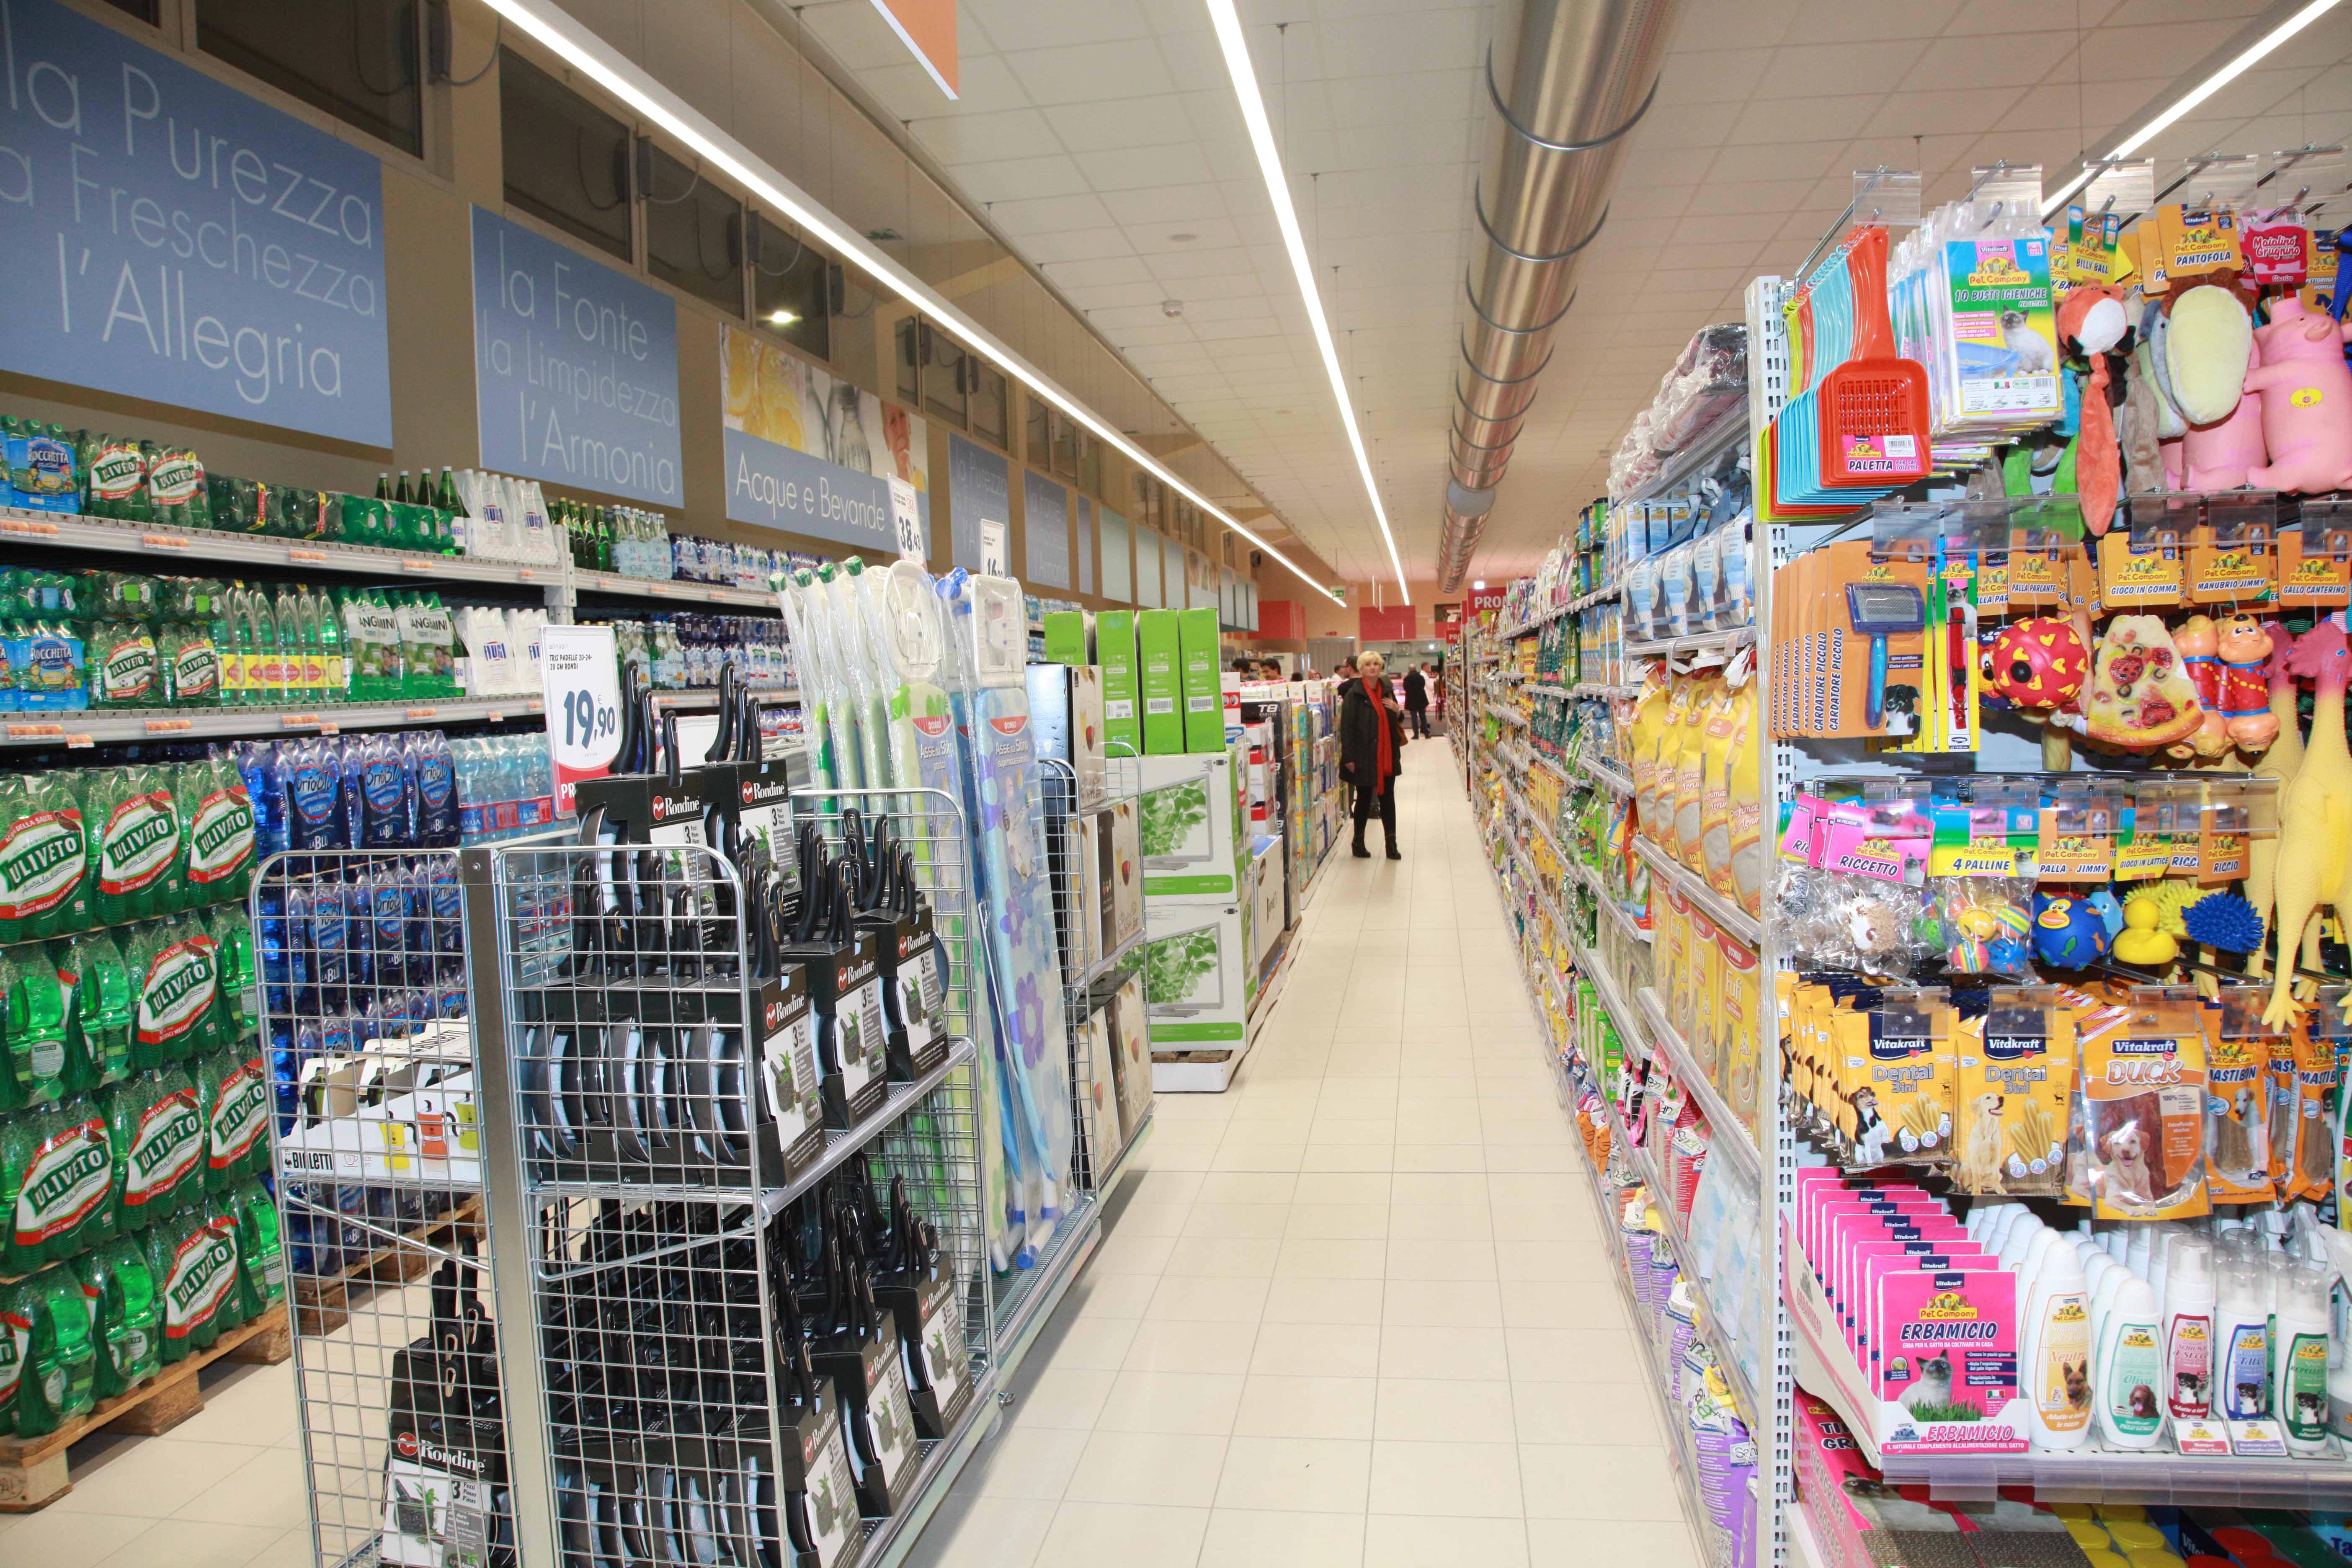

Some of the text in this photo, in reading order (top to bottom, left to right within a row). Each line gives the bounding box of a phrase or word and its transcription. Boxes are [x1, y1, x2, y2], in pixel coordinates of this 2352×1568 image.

[1, 0, 371, 249] la Purezza
[71, 142, 377, 318] Freschezza
[2190, 242, 2226, 251] Company
[2253, 235, 2296, 248] Maialino
[2175, 251, 2232, 266] PANTOFOLA
[2256, 246, 2300, 260] Grugnino
[2076, 257, 2108, 274] BILLY BALL
[1969, 275, 2027, 285] Pet Company
[499, 230, 648, 361] la Fonte
[1955, 288, 2047, 302] 10 BUSTE IGIENICHE
[57, 232, 342, 405] l'Allegria
[482, 311, 676, 428] la Limpidezza
[519, 391, 676, 495] l'Armonia
[1848, 459, 1893, 472] PALETTA
[736, 452, 885, 532] Acque e Bevande
[2133, 573, 2167, 582] Company
[2220, 569, 2256, 577] Company
[2029, 585, 2057, 593] PARLANTE
[2110, 586, 2134, 595] GIOCO
[2147, 585, 2177, 593] GOMMA
[2197, 579, 2265, 591] MANUBRIO JIMMY
[2306, 585, 2346, 594] CANTERINO
[31, 647, 73, 661] ROCCHETTA
[1813, 631, 1827, 732] CARDATORE PICCOLO
[1829, 627, 1844, 731] CARDATORE PICCOLO
[753, 781, 785, 799] Rondine
[665, 796, 700, 816] Rondine
[16, 820, 35, 831] DELLA
[771, 808, 778, 826] 3
[685, 825, 691, 844] 3
[9, 837, 77, 884] ULIVETO
[1839, 855, 1898, 876] RICCETTO
[1952, 858, 2010, 871] 4 PALLINE
[2039, 863, 2107, 874] PALLA JIMMY
[2120, 860, 2137, 868] GIOCO
[2147, 856, 2169, 866] LATTICE
[2213, 861, 2239, 873] RICCIO
[907, 931, 931, 952] Rondine
[847, 959, 874, 984] Rondine
[921, 956, 926, 975] 3
[1725, 968, 1742, 1003] Fufi
[862, 988, 867, 1008] 3
[776, 993, 805, 1022] Rondine
[792, 1026, 798, 1047] 3
[1873, 1038, 1925, 1050] Vitakraft
[1989, 1039, 2041, 1049] Vitakraft
[2114, 1040, 2176, 1052] Vitakraft
[1872, 1063, 1934, 1082] Dental
[1985, 1065, 2047, 1082] Dental
[2106, 1060, 2182, 1086] DUCK
[1891, 1080, 1917, 1093] 3in1
[2003, 1081, 2030, 1094] 3in1
[140, 1114, 198, 1170] ULIVETO
[34, 1149, 102, 1207] ULIVETO
[928, 1277, 951, 1310] Rondine
[1937, 1310, 1975, 1318] Company
[1900, 1321, 1998, 1341] ERBAMICIO
[874, 1338, 896, 1375] Rondine
[812, 1406, 836, 1452] Rondine
[1926, 1425, 2014, 1442] ERBAMICIO
[421, 1439, 485, 1473] Rondine
[451, 1480, 476, 1499] 3 Pezzi
[463, 1489, 476, 1497] Pieces
